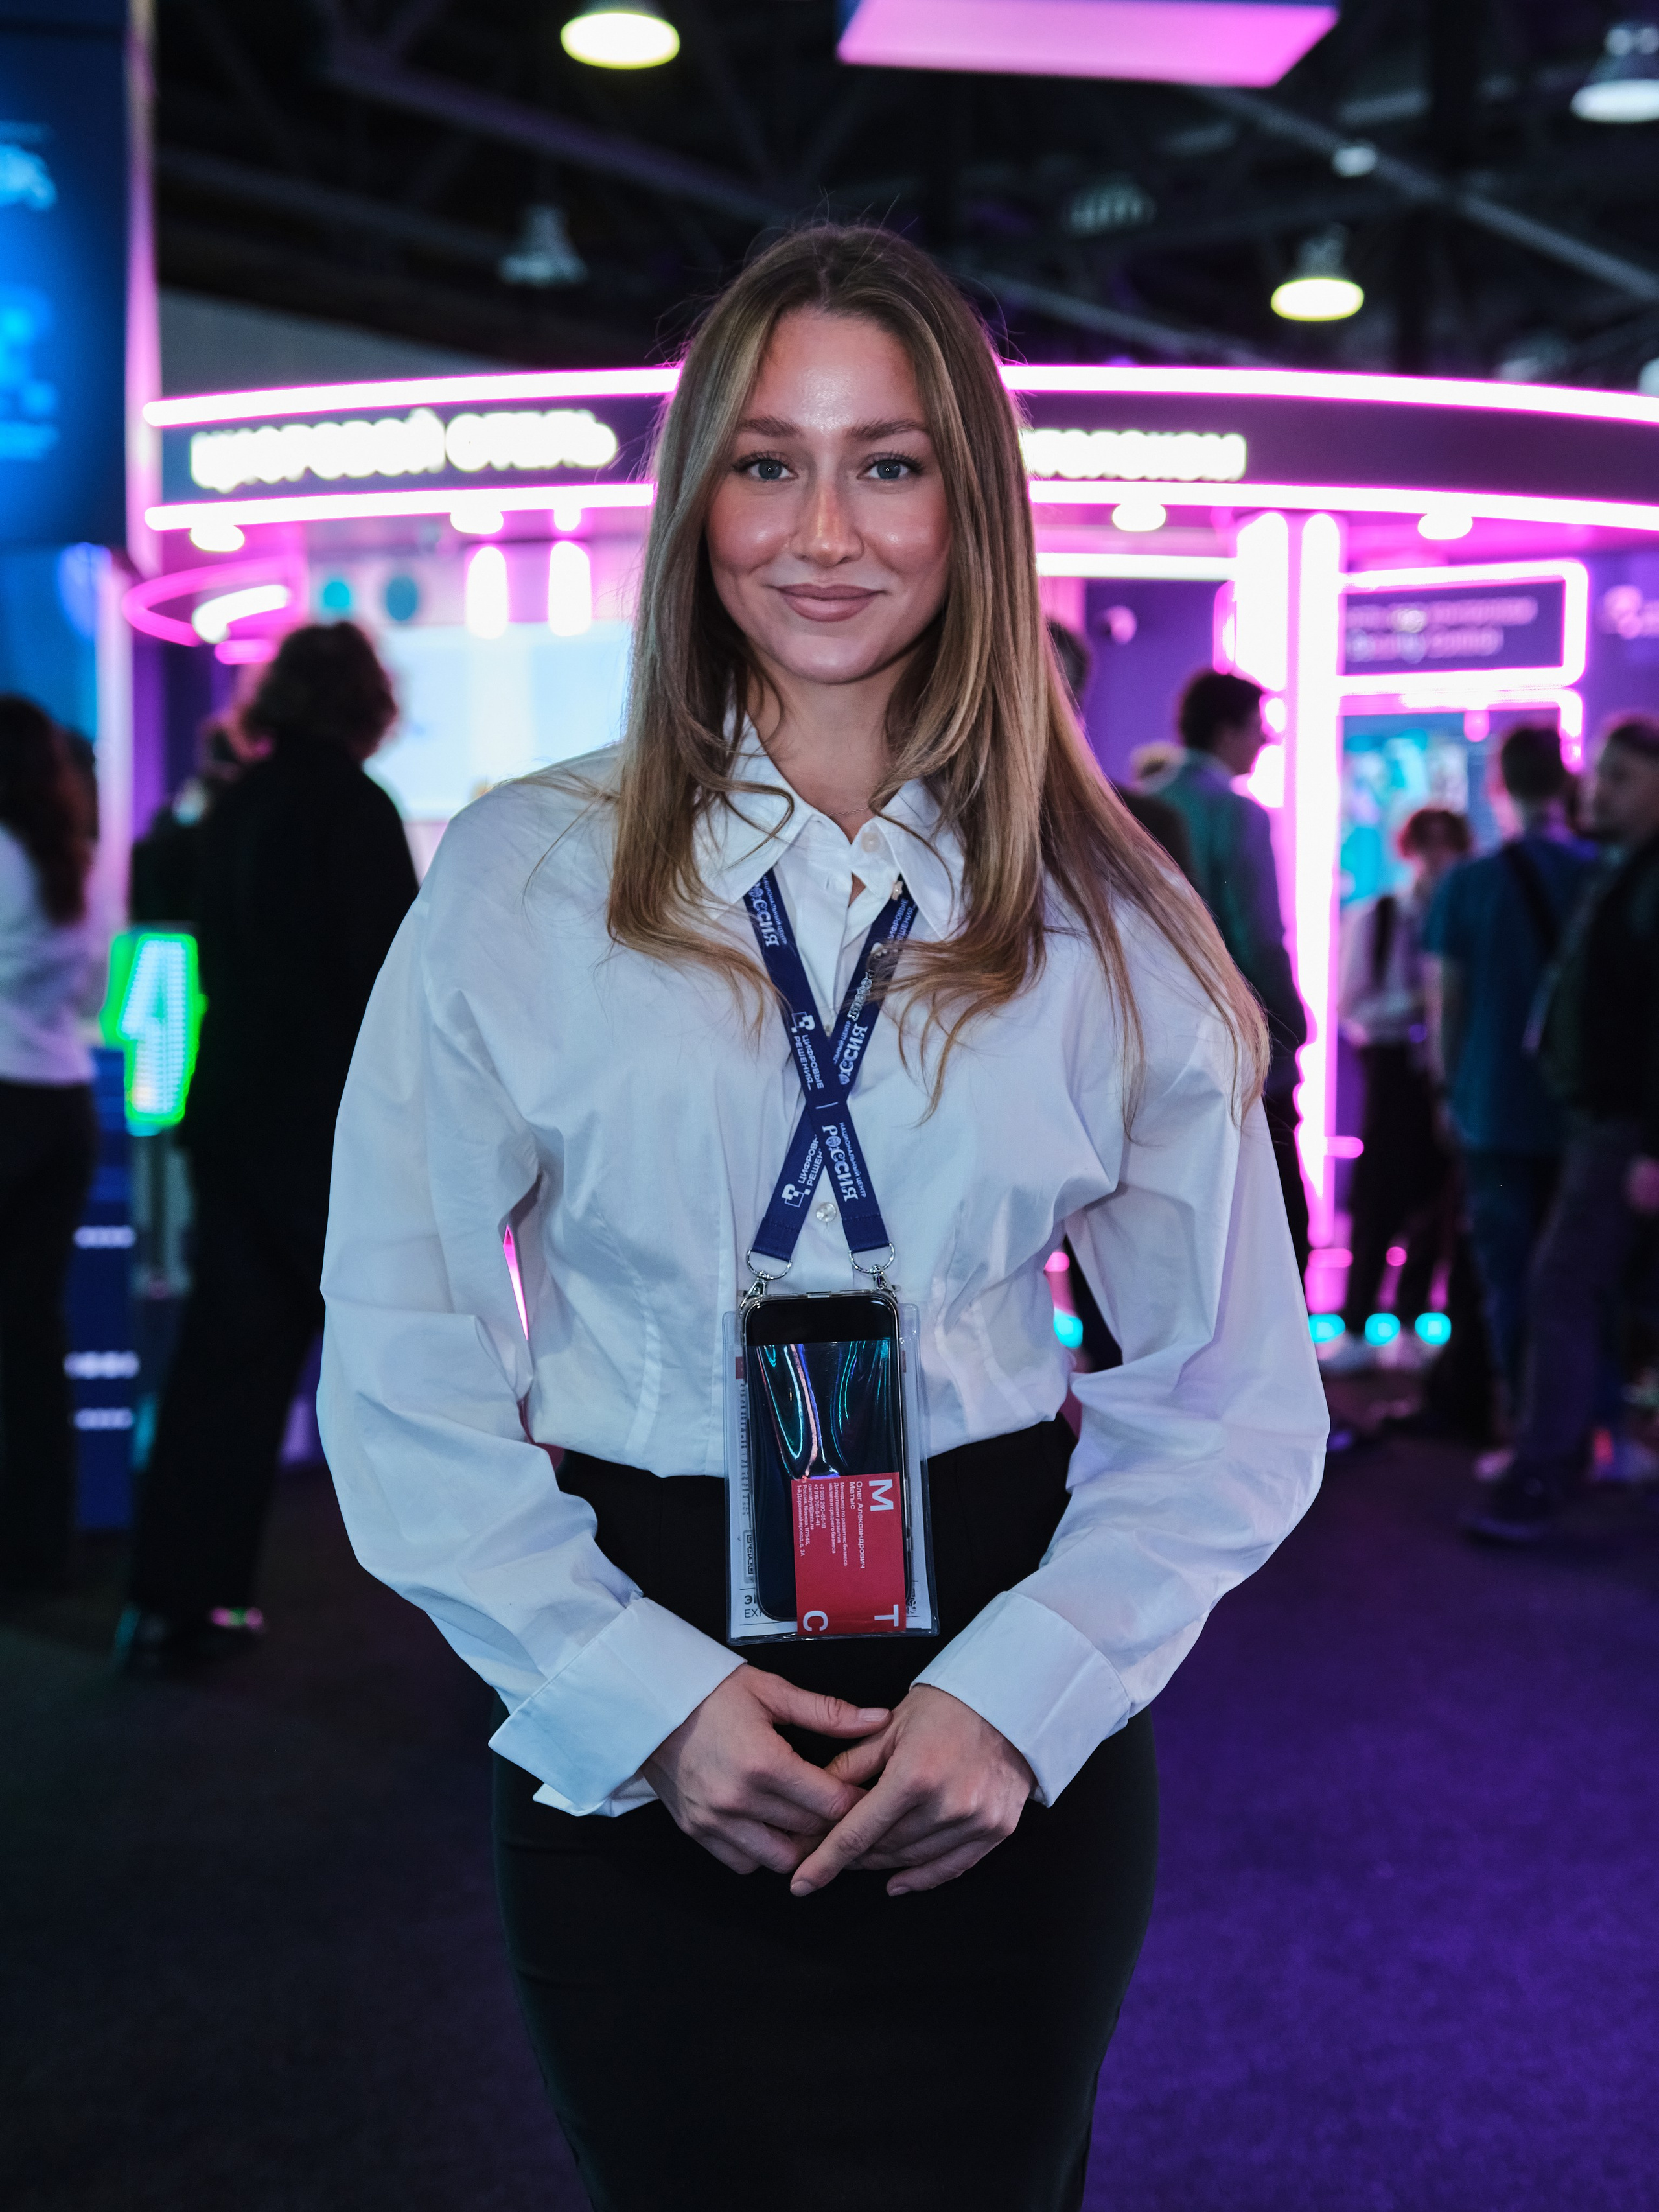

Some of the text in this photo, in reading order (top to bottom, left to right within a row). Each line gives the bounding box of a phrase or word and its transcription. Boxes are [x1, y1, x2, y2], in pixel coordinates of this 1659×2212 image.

[748, 881, 780, 946] ОССИЯ
[763, 876, 787, 944] НАЦИОНАЛЬНЫЙ ЦЕНТР
[802, 1034, 824, 1089] ЦИФРОВЫЕ
[841, 1020, 851, 1040] ЦЕНТР
[822, 1124, 859, 1202] РОССИЯ
[839, 1122, 867, 1198] НАЦИОНАЛЬНЫЙ ЦЕНТР
